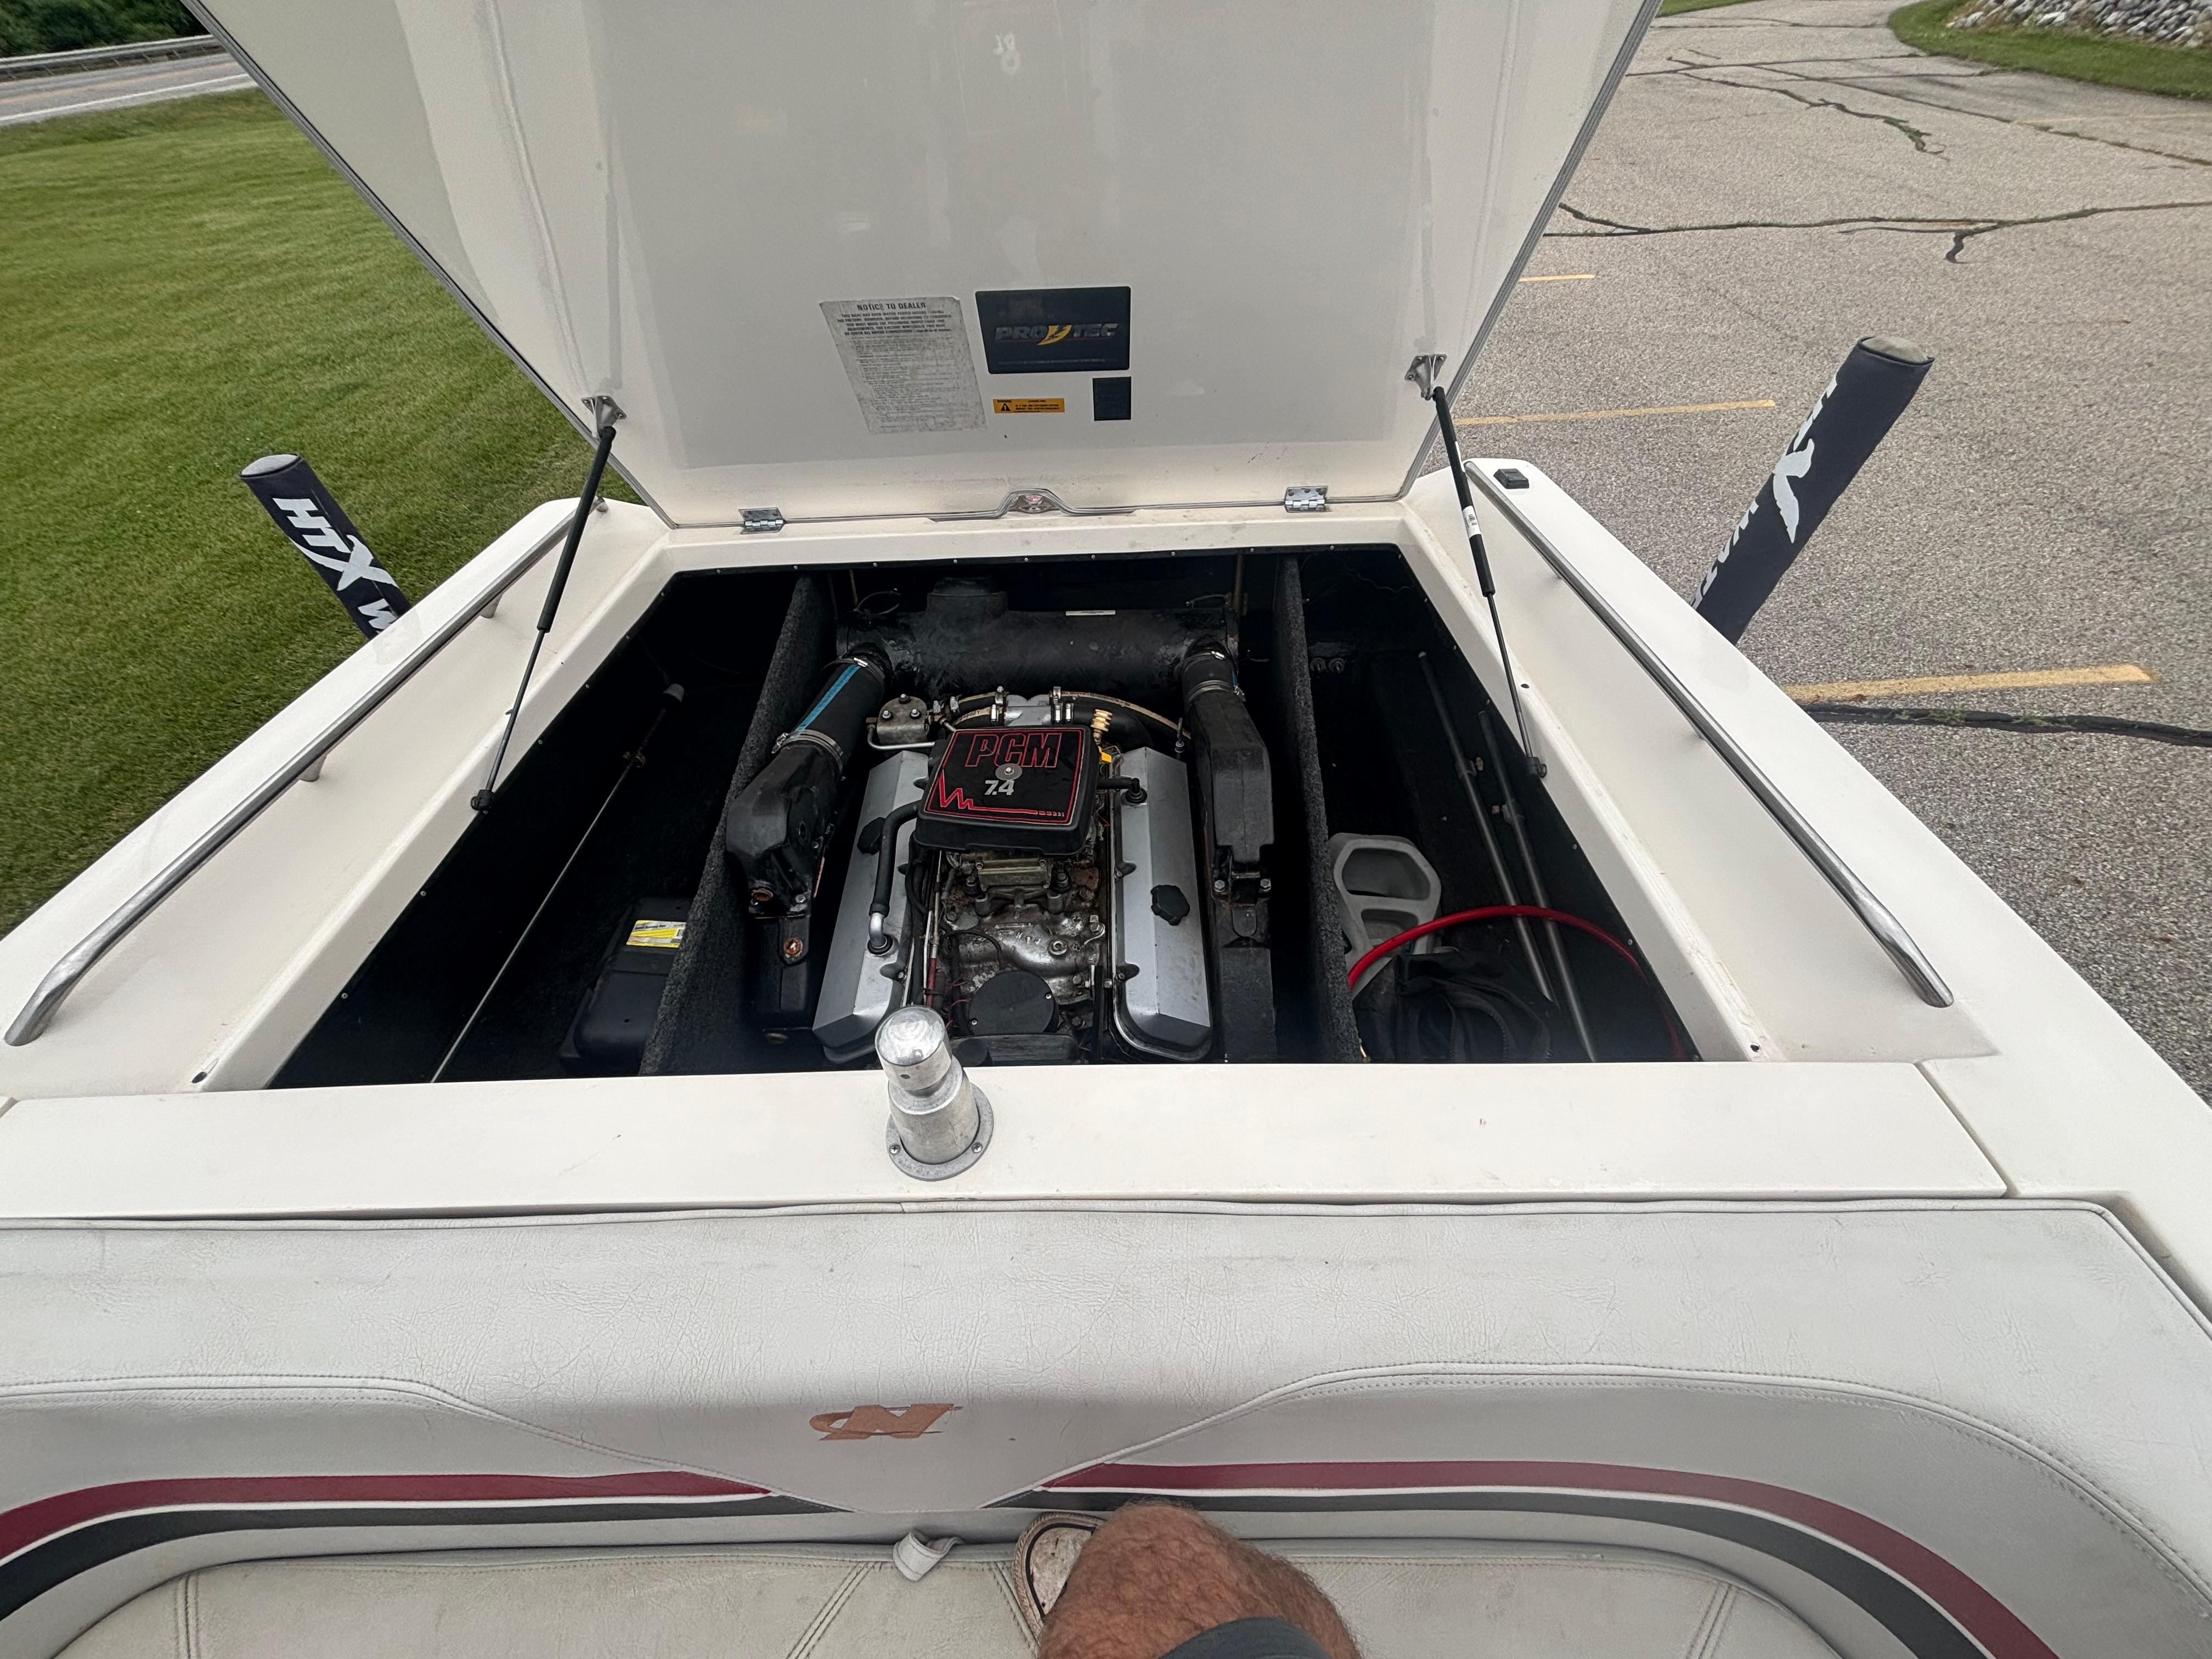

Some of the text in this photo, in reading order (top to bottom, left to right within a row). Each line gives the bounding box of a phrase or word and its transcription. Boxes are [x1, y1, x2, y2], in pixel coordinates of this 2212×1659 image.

[857, 303, 884, 311] NOTICE
[272, 498, 399, 591] HTX
[965, 733, 1062, 768] PCM
[984, 780, 1014, 795] 7.4
